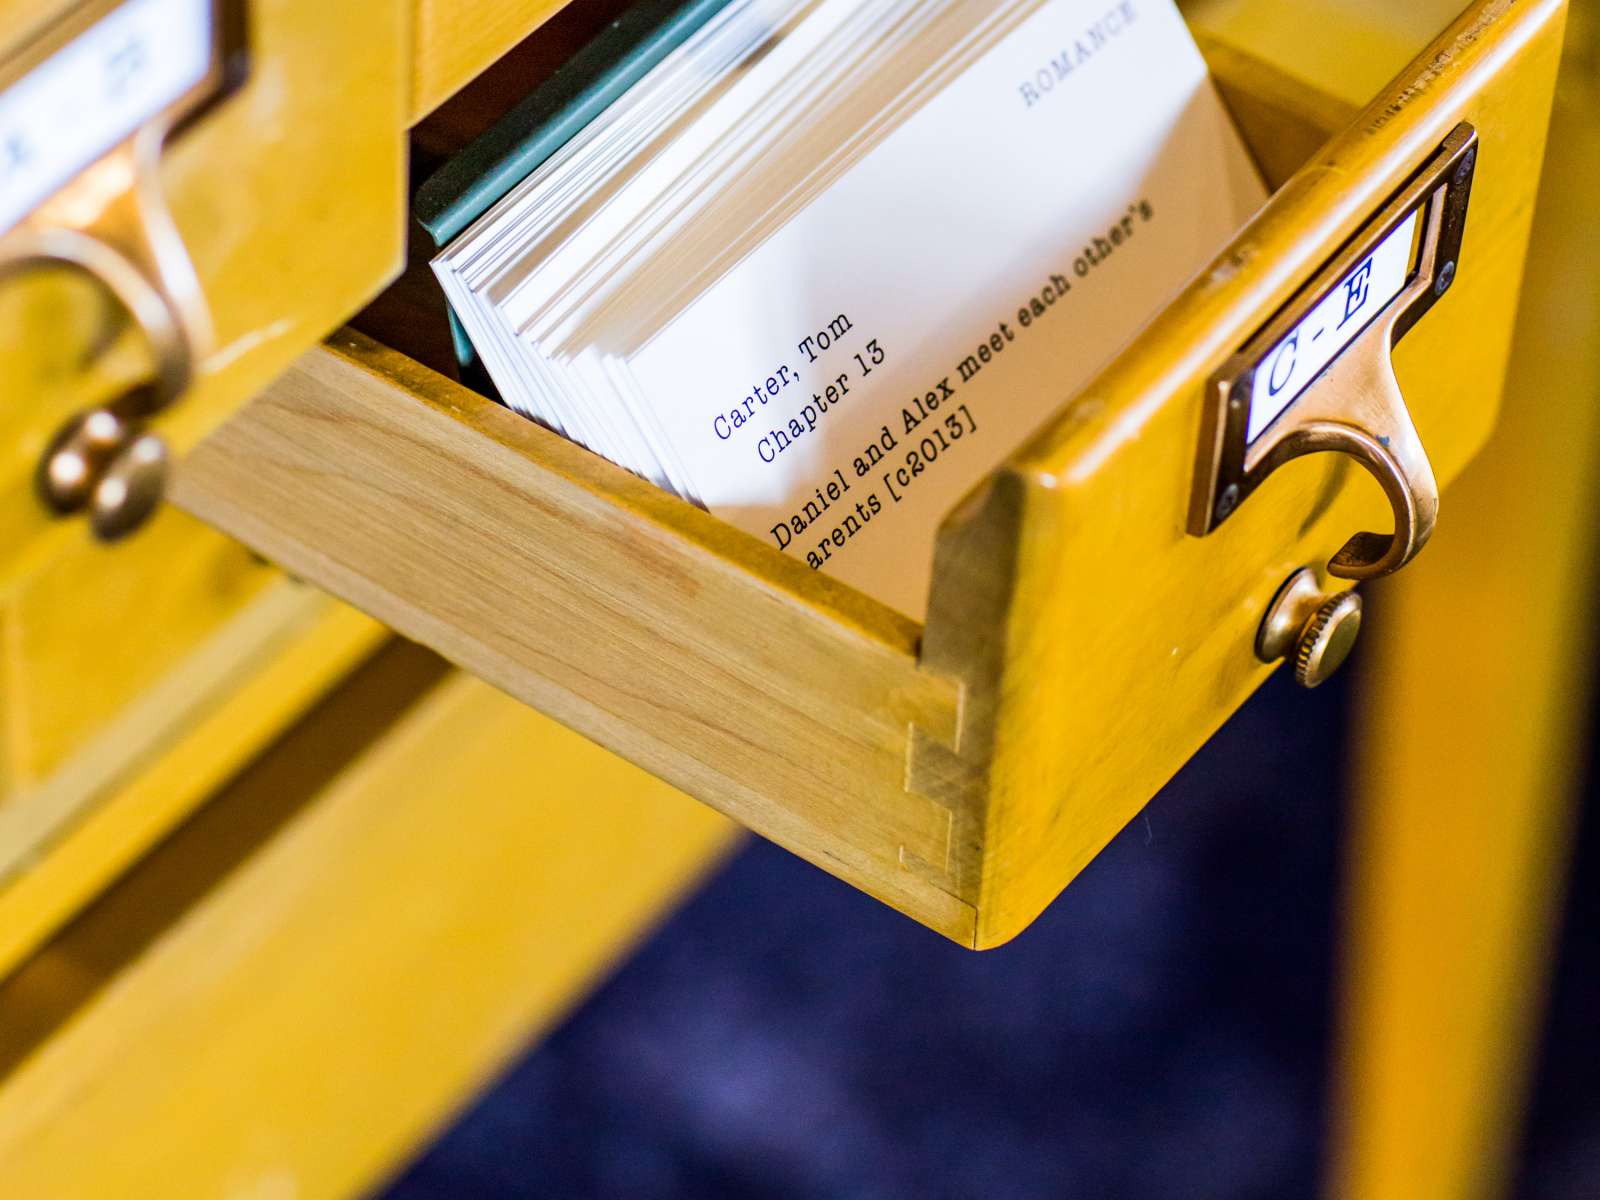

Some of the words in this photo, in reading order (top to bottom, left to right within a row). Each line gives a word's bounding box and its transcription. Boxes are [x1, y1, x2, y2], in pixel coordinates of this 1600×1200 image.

[713, 364, 800, 440] Carter,
[798, 312, 853, 363] Tom
[769, 469, 851, 551] Daniel
[852, 425, 898, 477] and
[900, 376, 956, 435] Alex
[955, 321, 1015, 383] meet
[1017, 273, 1072, 328] each
[1073, 197, 1154, 278] other's
[1268, 330, 1300, 397] C
[1336, 256, 1374, 330] E
[757, 373, 851, 463] Chapter
[853, 338, 885, 377] 13
[882, 404, 978, 502] [c2013]
